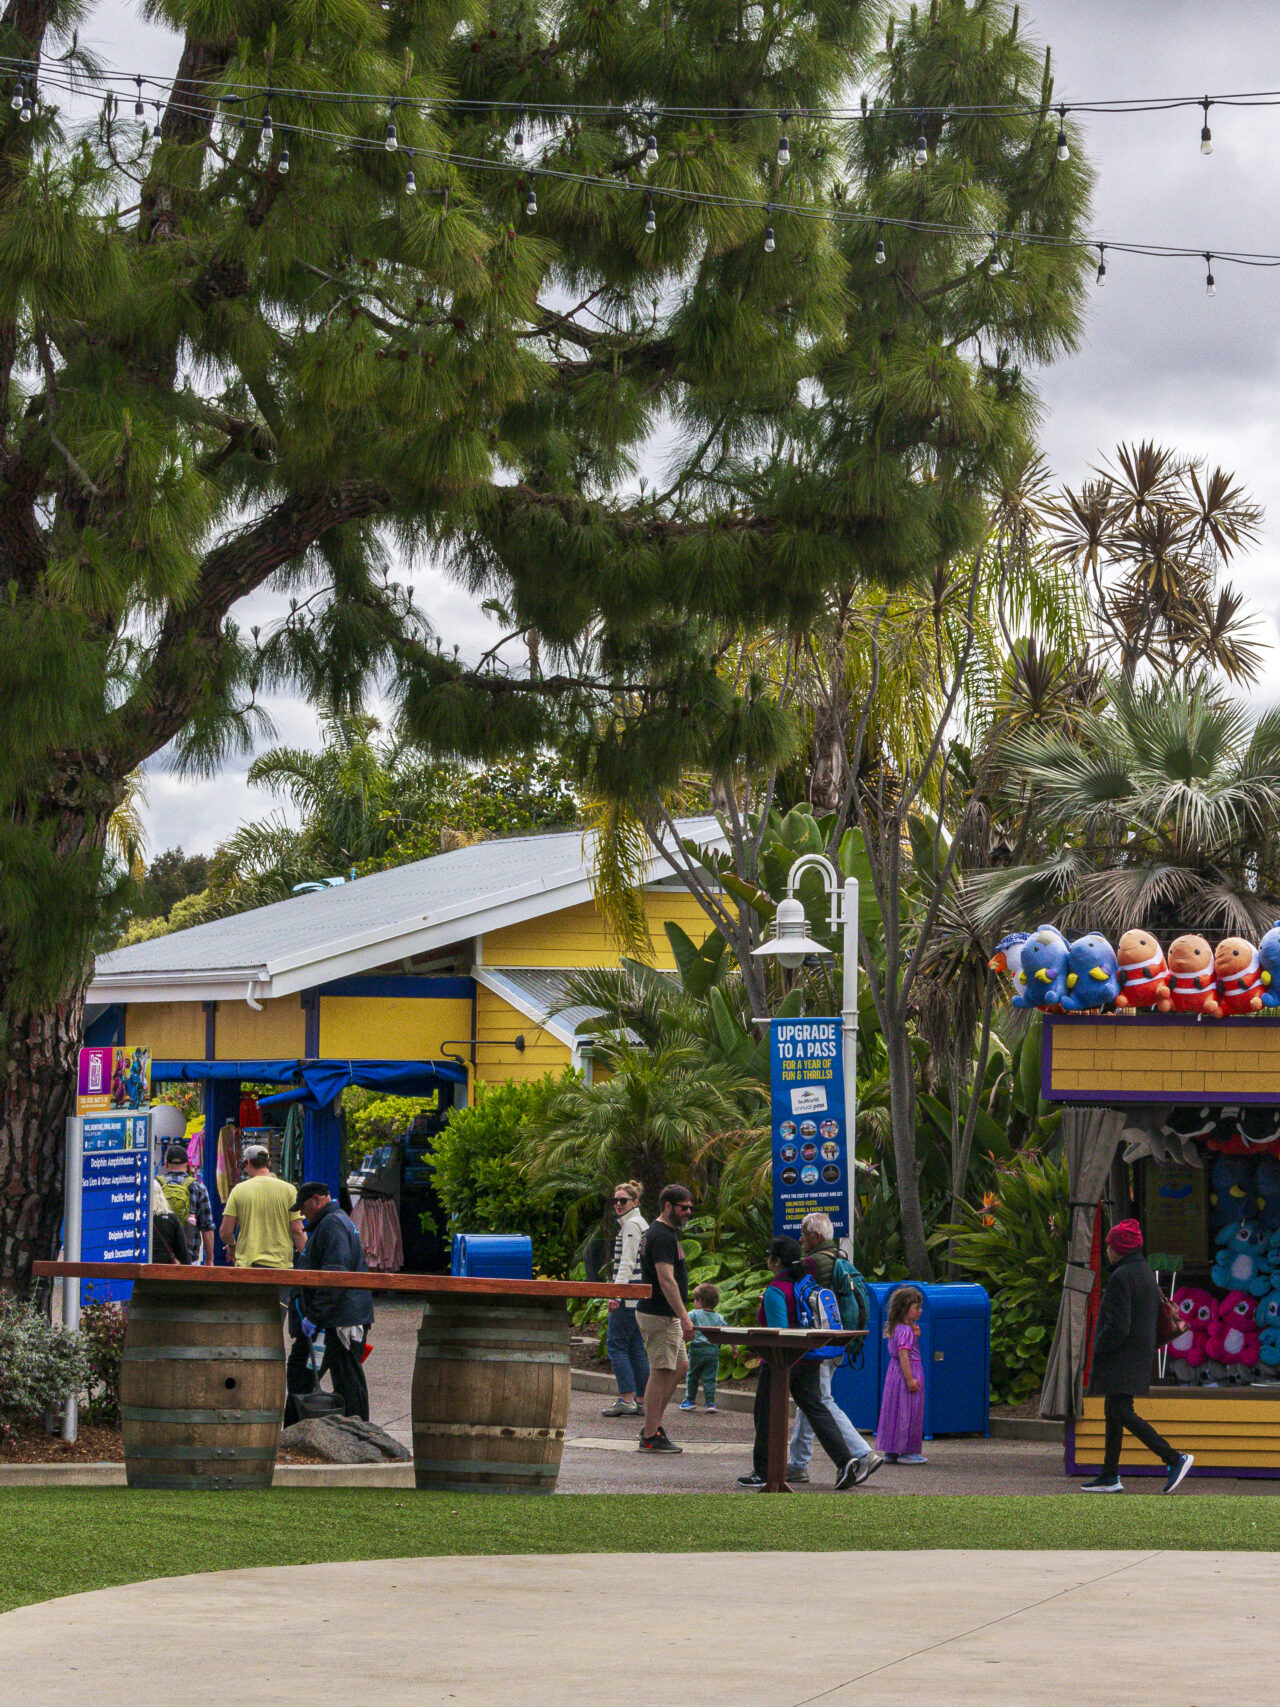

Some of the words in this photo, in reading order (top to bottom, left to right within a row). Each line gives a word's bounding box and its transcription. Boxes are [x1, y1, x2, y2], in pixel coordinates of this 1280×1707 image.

[778, 1024, 836, 1041] UPGRADE
[778, 1043, 793, 1058] TO
[796, 1043, 804, 1057] A
[807, 1042, 837, 1057] PASS
[782, 1060, 796, 1070] FOR
[797, 1060, 802, 1069] A
[803, 1059, 821, 1069] YEAR
[822, 1059, 832, 1068] OF
[782, 1071, 796, 1080] FUN
[797, 1070, 802, 1080] &
[803, 1069, 833, 1080] THRILLS!
[90, 1158, 107, 1169] Dolphin
[108, 1156, 134, 1168] Amphitheater
[89, 1178, 98, 1186] Lion
[101, 1176, 111, 1185] Otter
[111, 1175, 135, 1186] Amphitheater
[111, 1194, 124, 1203] Pacific
[124, 1193, 135, 1202] Point
[122, 1212, 135, 1220] Manta
[108, 1231, 123, 1241] Dolphin
[123, 1230, 135, 1239] Point
[103, 1250, 115, 1260] Shark
[115, 1249, 134, 1258] Encounter
